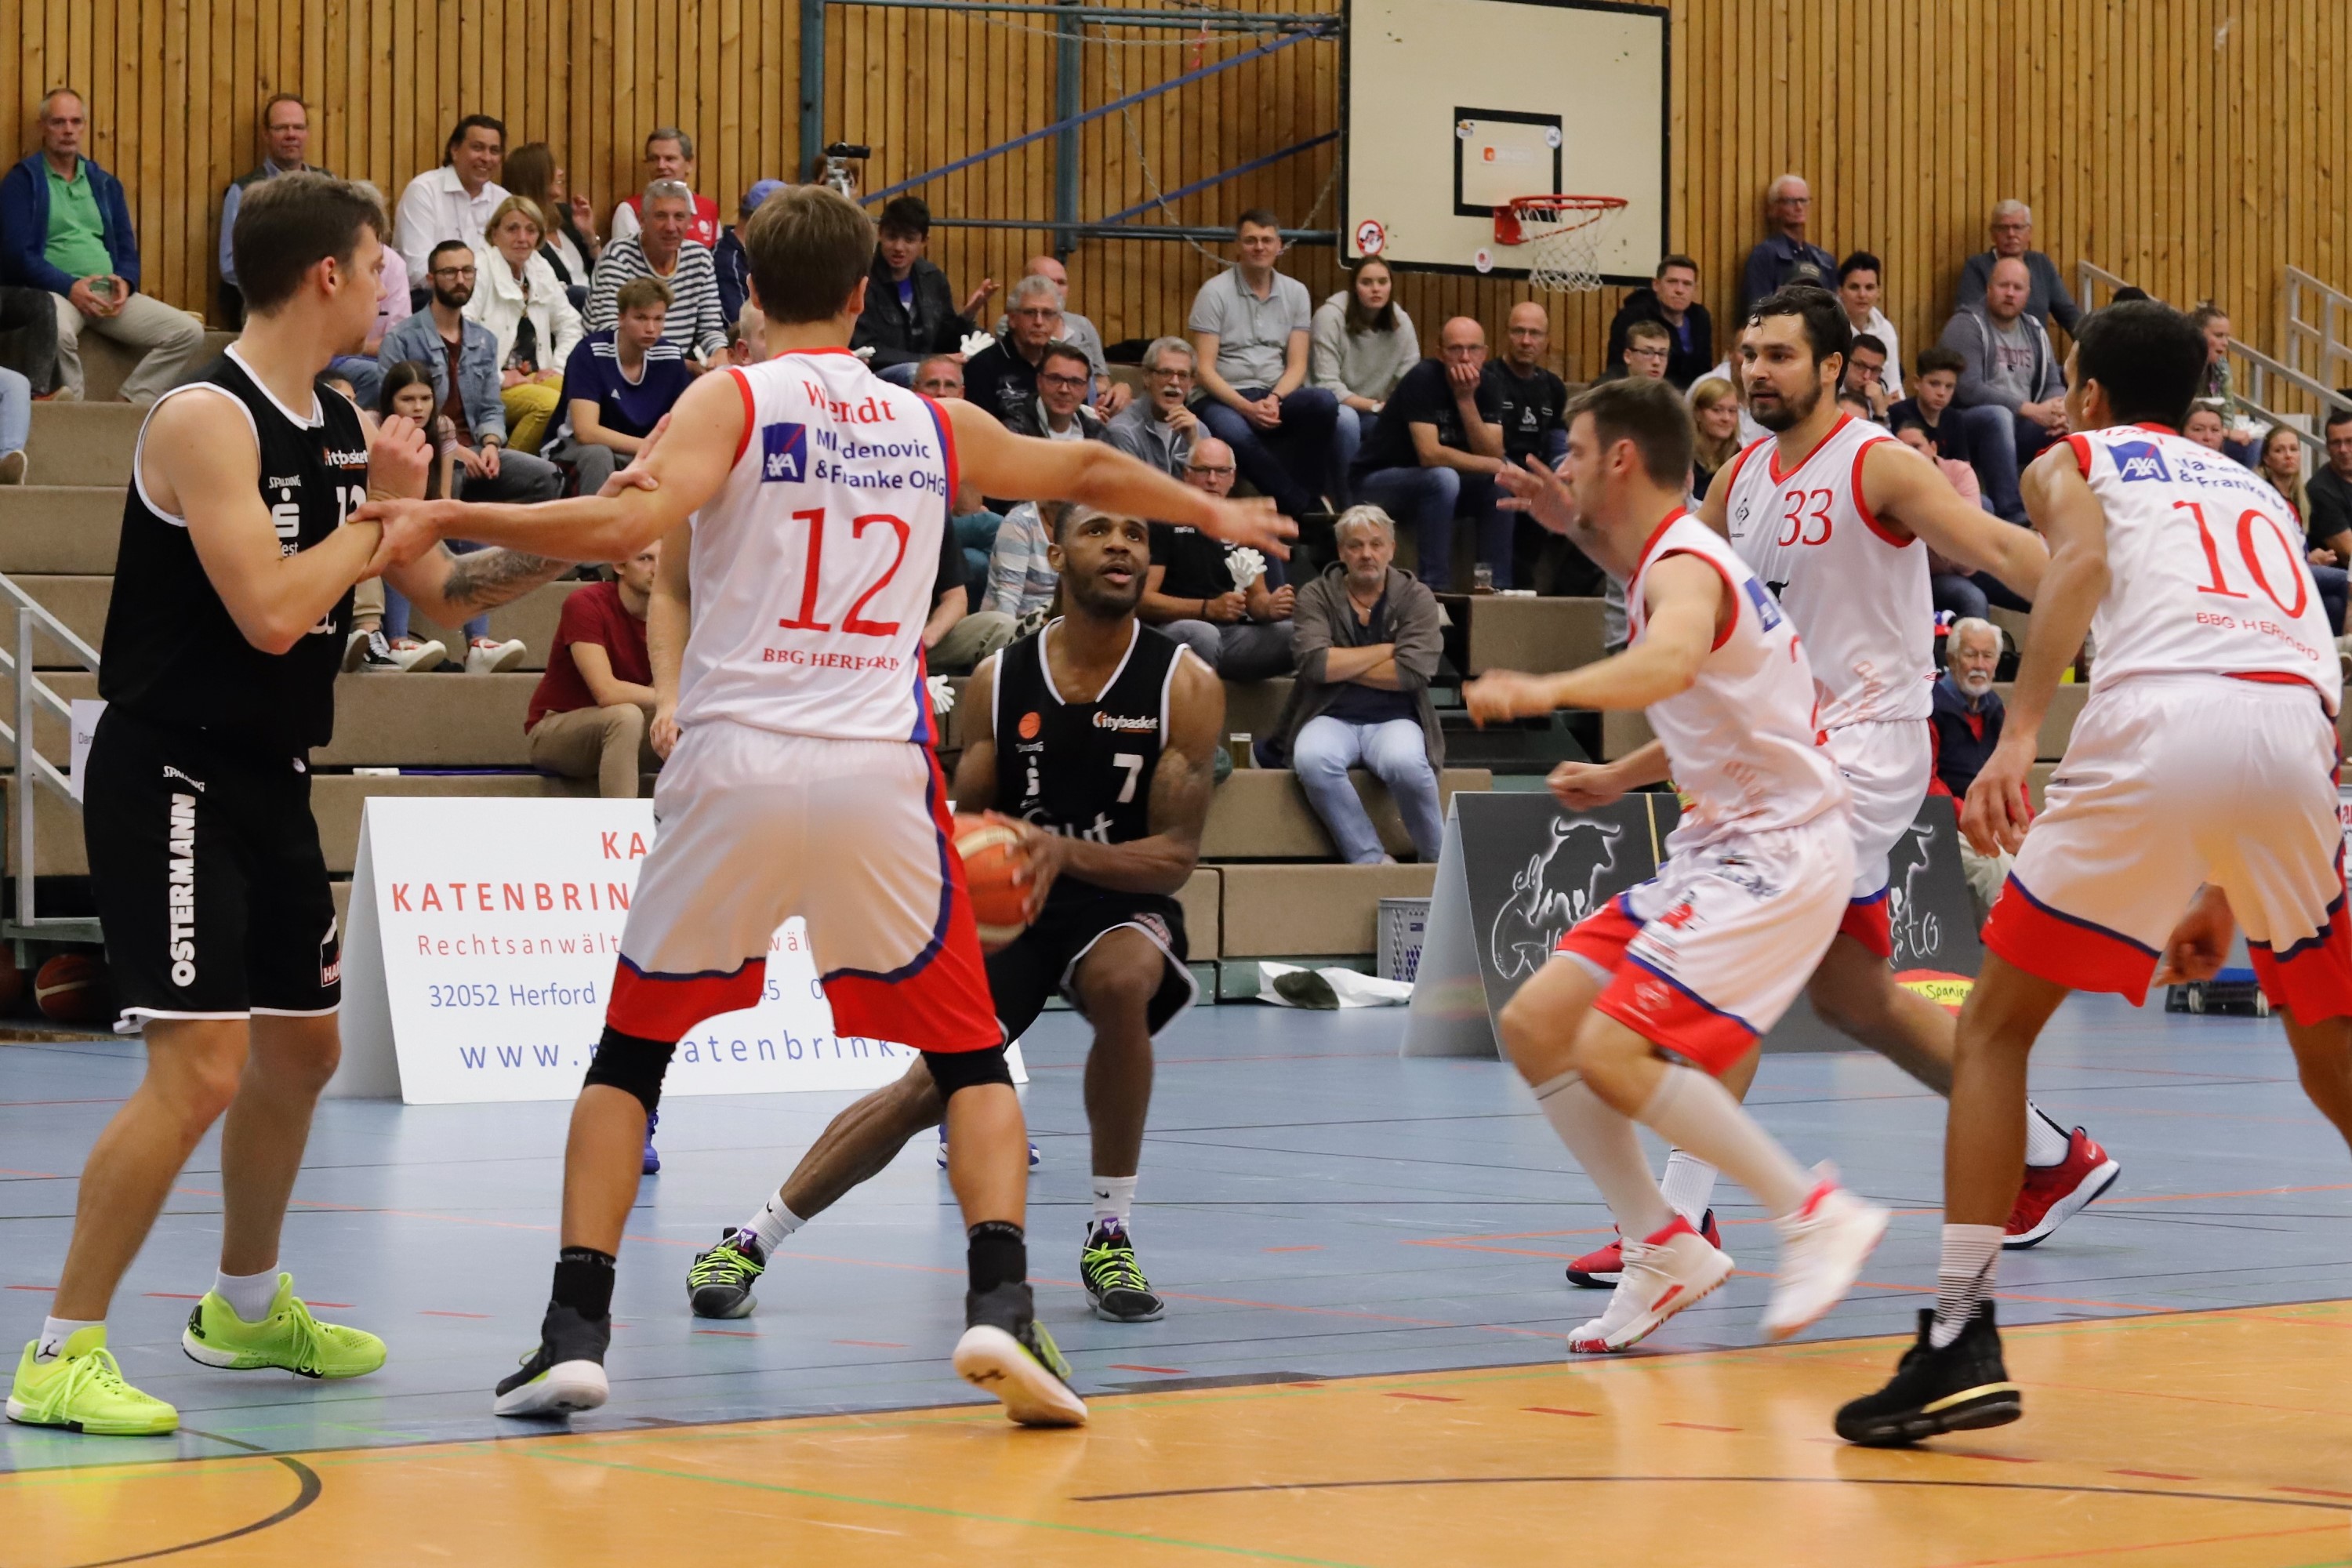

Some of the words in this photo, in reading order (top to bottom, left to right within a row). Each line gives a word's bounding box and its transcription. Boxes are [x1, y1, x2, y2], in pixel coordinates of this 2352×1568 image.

[802, 381, 896, 424] Wendt
[816, 428, 931, 460] Mldenovic
[815, 459, 828, 479] &
[909, 470, 946, 497] OHG
[2120, 456, 2169, 481] AXA
[1777, 488, 1833, 546] 33
[279, 541, 299, 557] est
[2172, 500, 2307, 619] 10
[779, 507, 911, 637] 12
[762, 648, 804, 664] BBG
[1112, 753, 1144, 804] 7
[169, 793, 196, 987] OSTERMANN
[429, 985, 499, 1007] 32052
[510, 982, 596, 1007] Herford
